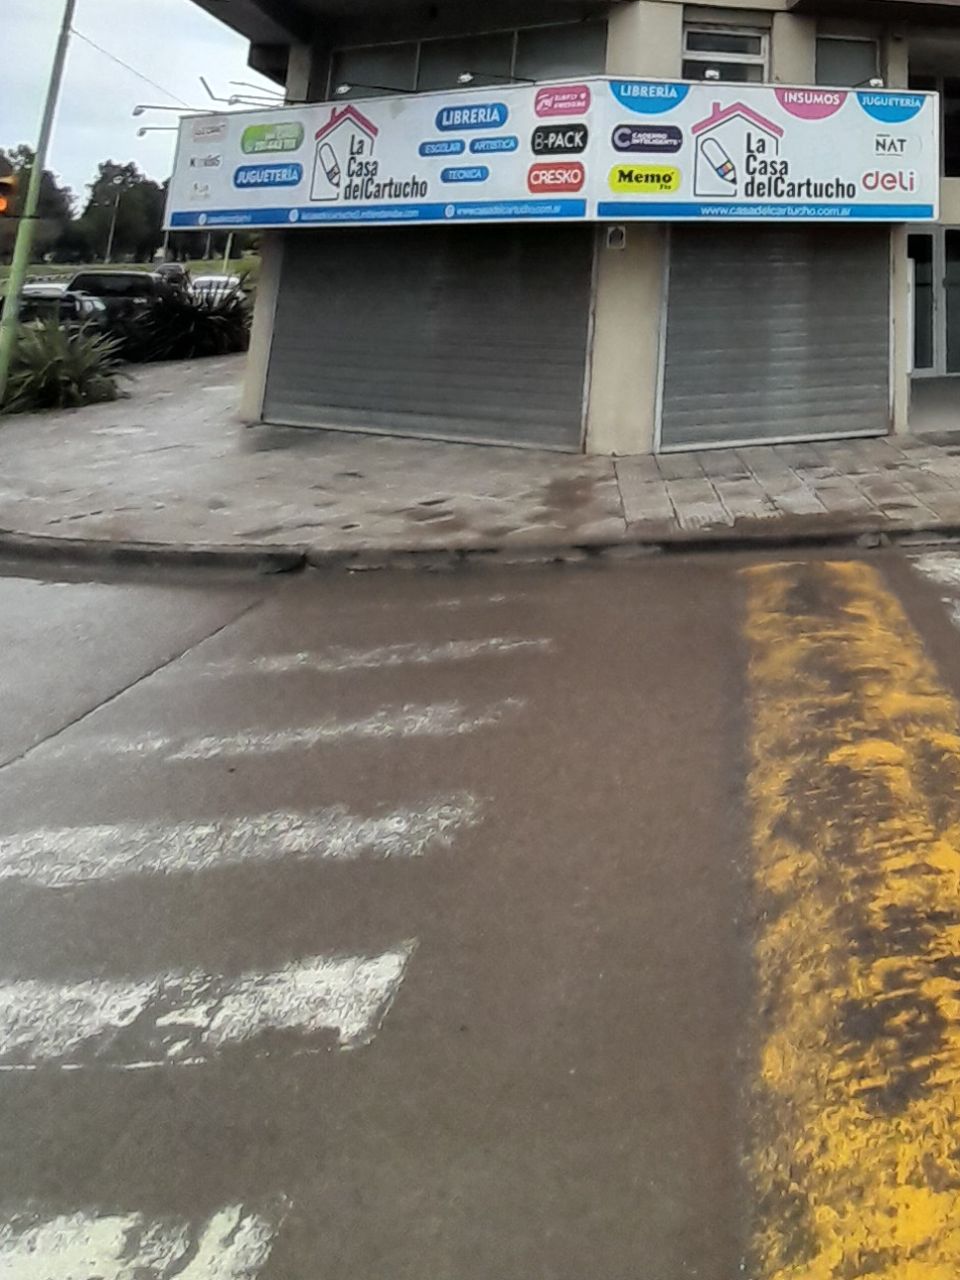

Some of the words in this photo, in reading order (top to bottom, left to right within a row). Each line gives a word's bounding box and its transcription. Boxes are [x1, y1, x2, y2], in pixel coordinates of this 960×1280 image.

[620, 85, 678, 98] LIBRERÍA
[784, 92, 841, 105] INSUMOS
[862, 96, 922, 108] JUGUETERÍA
[442, 107, 501, 126] LIBRERÍA
[350, 134, 364, 155] La
[425, 141, 461, 153] ESCOLAR
[534, 131, 584, 150] B-PACK
[746, 132, 766, 154] La
[875, 138, 907, 152] NAT
[347, 156, 378, 178] Casa
[745, 155, 789, 177] Casa
[236, 168, 299, 184] JUGUETERÍA
[530, 169, 581, 185] CRESKO
[618, 170, 673, 183] Memo
[862, 170, 914, 191] deli
[344, 175, 428, 200] delCartucho
[744, 176, 856, 199] delCartucho
[700, 205, 851, 216] www.casadelcartucho.com.ar
